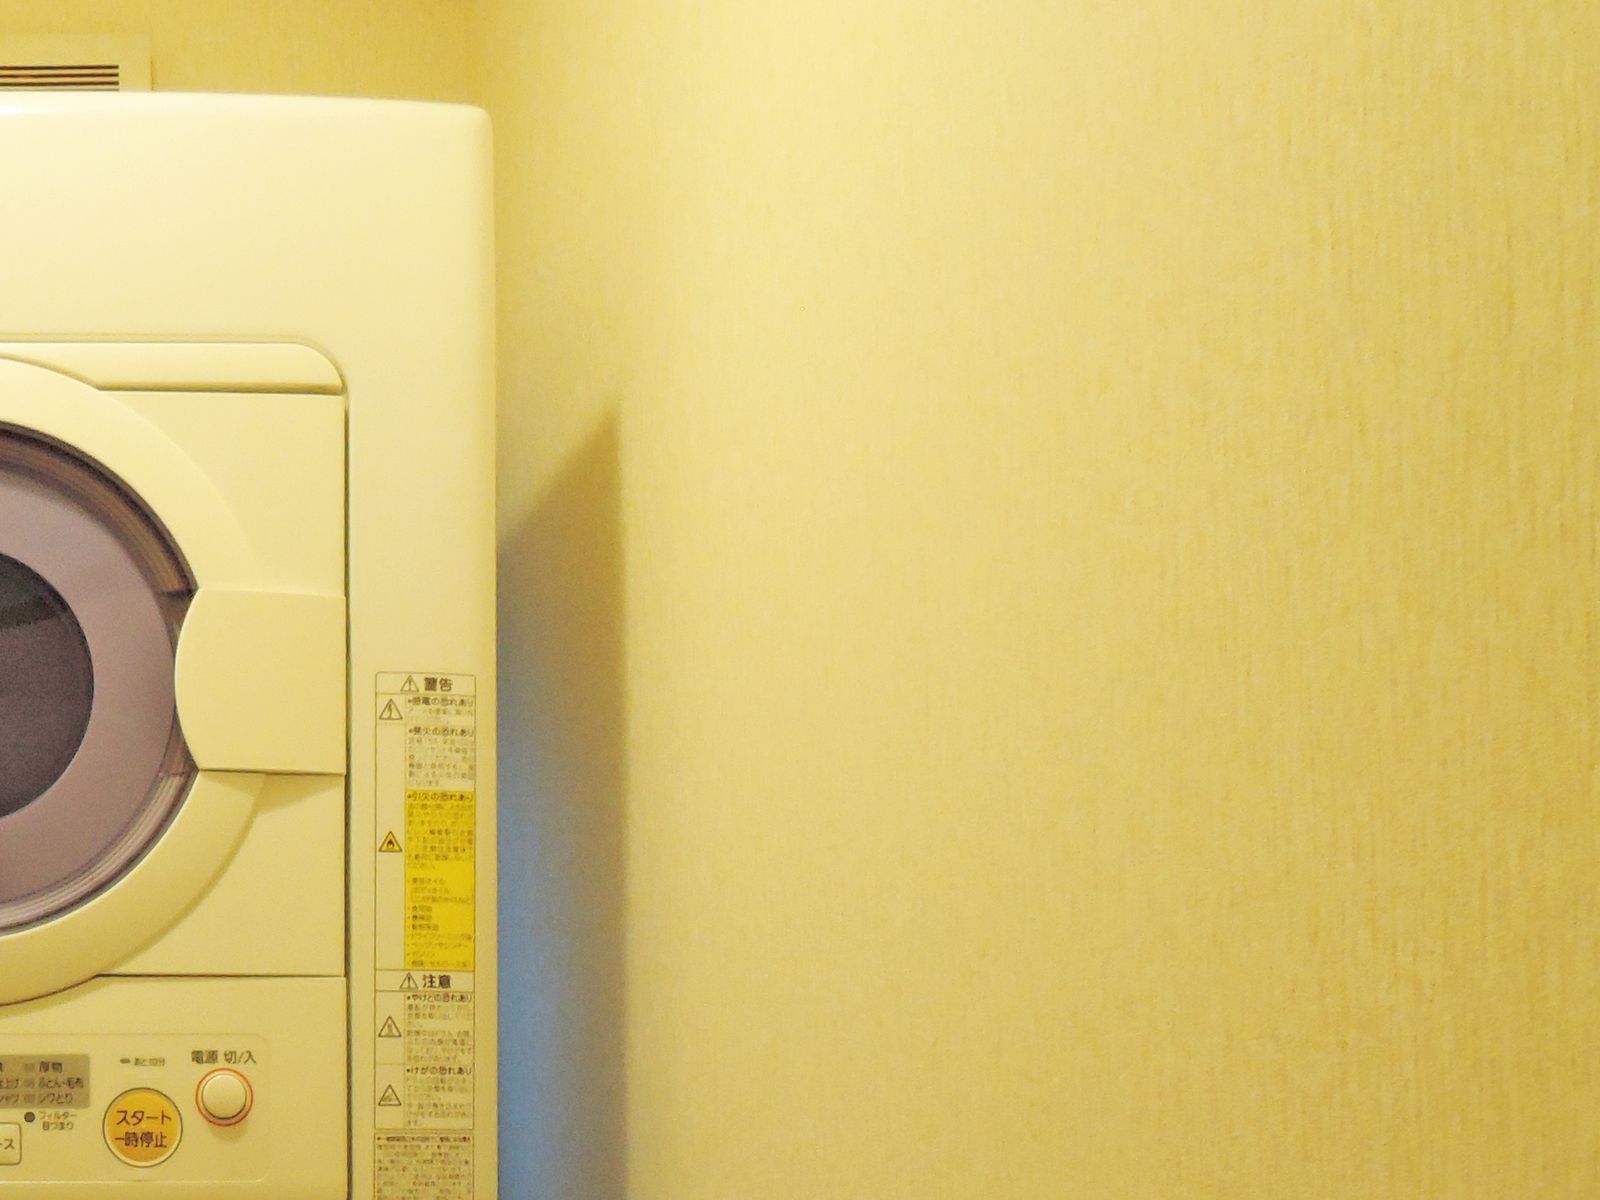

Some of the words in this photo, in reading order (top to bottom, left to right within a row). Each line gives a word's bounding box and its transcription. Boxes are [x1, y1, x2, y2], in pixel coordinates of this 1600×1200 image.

[424, 677, 453, 692] 警告
[422, 974, 451, 989] 注意
[191, 1050, 218, 1064] 電源
[223, 1050, 256, 1064] 切/入
[116, 1109, 171, 1126] スタート
[114, 1131, 167, 1148] 一時停止
